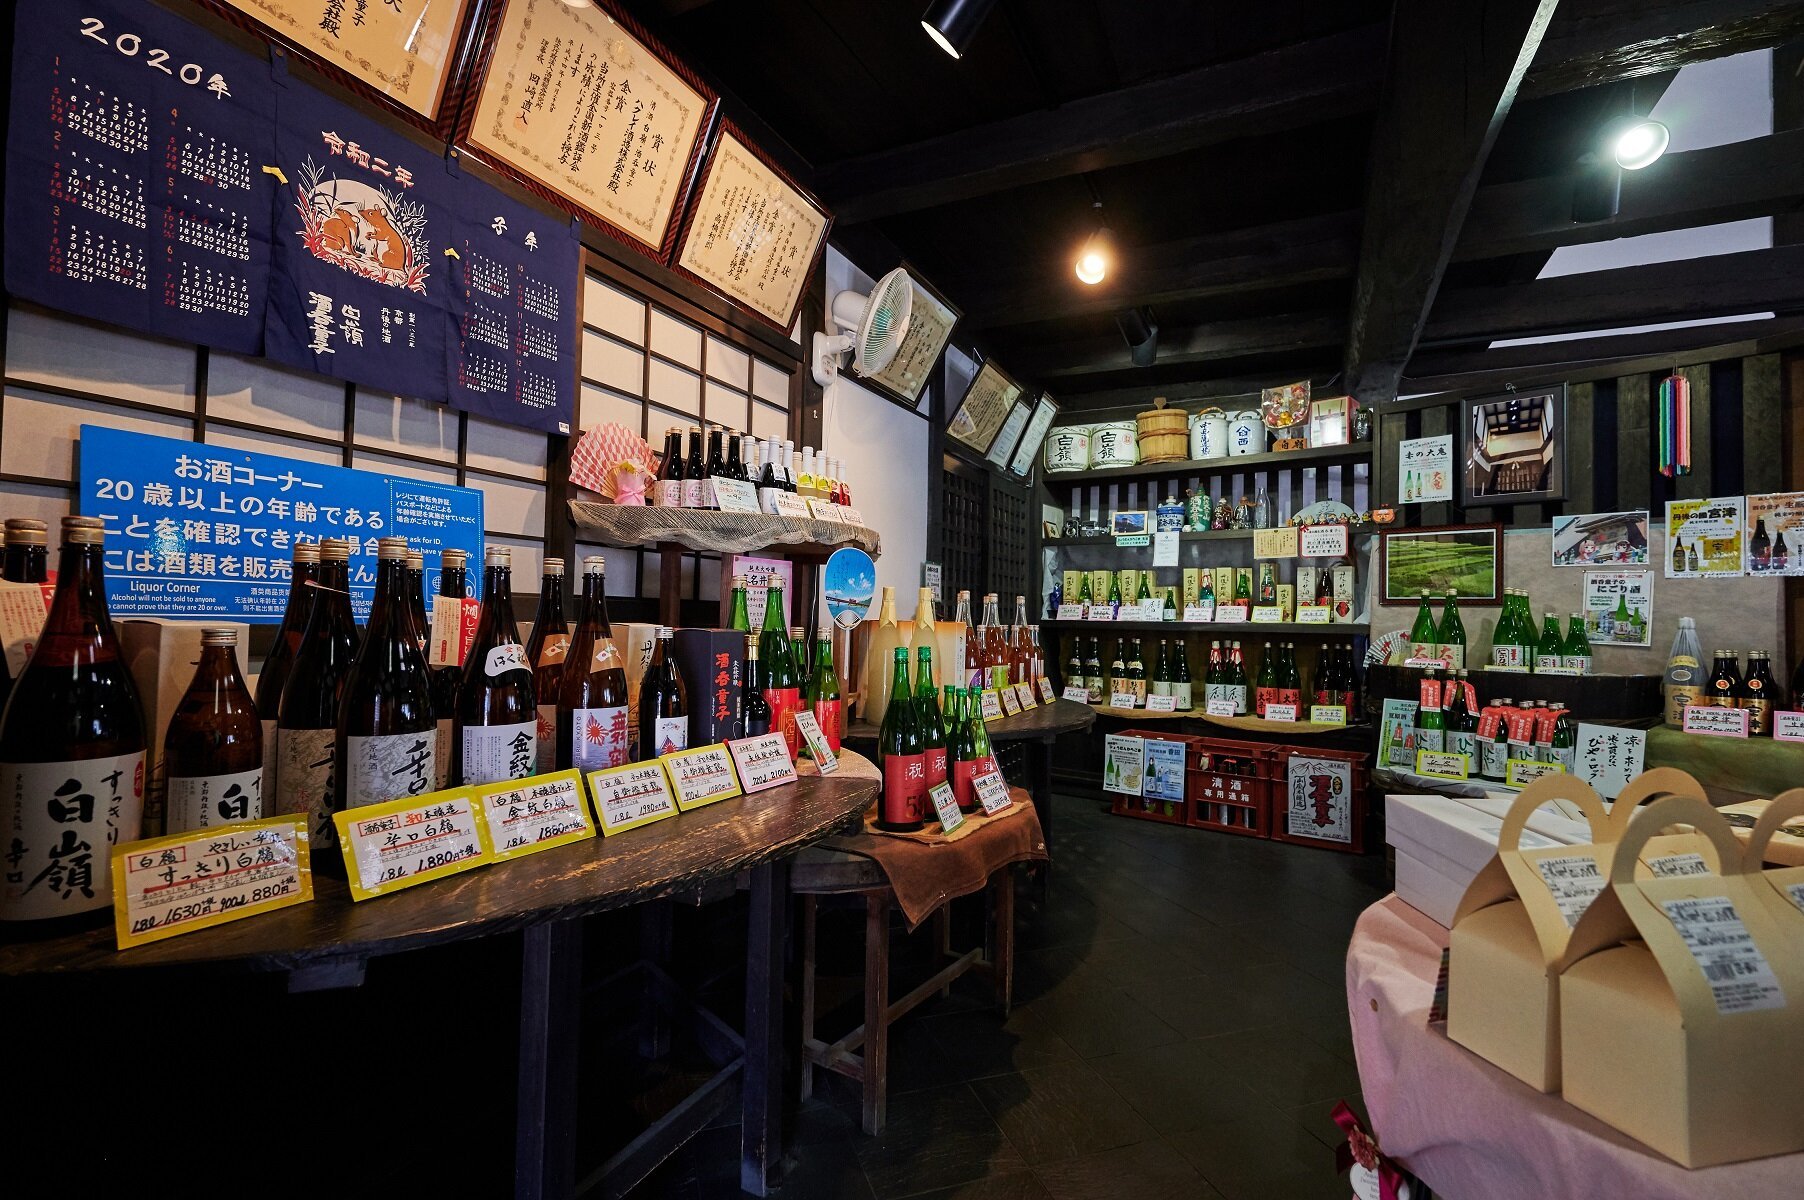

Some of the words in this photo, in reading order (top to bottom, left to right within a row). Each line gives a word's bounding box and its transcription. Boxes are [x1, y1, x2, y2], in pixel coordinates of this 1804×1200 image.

[80, 17, 231, 99] 2020年
[570, 43, 584, 78] します
[614, 79, 632, 113] 金賞
[322, 131, 415, 188] 令和二年
[1055, 434, 1074, 461] 白嶺
[1098, 431, 1117, 459] 白嶺
[174, 454, 323, 492] お酒コーナー
[396, 507, 476, 524] 年齢確認を実施させていただく
[396, 515, 447, 528] 場合がございます。
[420, 548, 437, 556] have
[130, 580, 164, 593] Liquor
[166, 582, 200, 593] Corner
[1597, 585, 1641, 593] にごり酒
[715, 653, 731, 721] 酒呑童子
[368, 744, 378, 771] 京地酒
[392, 739, 432, 796] 辛口
[507, 731, 533, 778] 金紋
[935, 756, 947, 772] 祝
[909, 762, 924, 779] 祝
[1212, 777, 1241, 791] 清酒
[101, 769, 123, 845] すっきり
[1204, 788, 1250, 802] 専用通箱
[22, 778, 95, 900] 白嶺
[384, 818, 456, 848] 辛口白嶺
[5, 837, 30, 883] 辛口
[158, 847, 276, 888] すっきり白嶺
